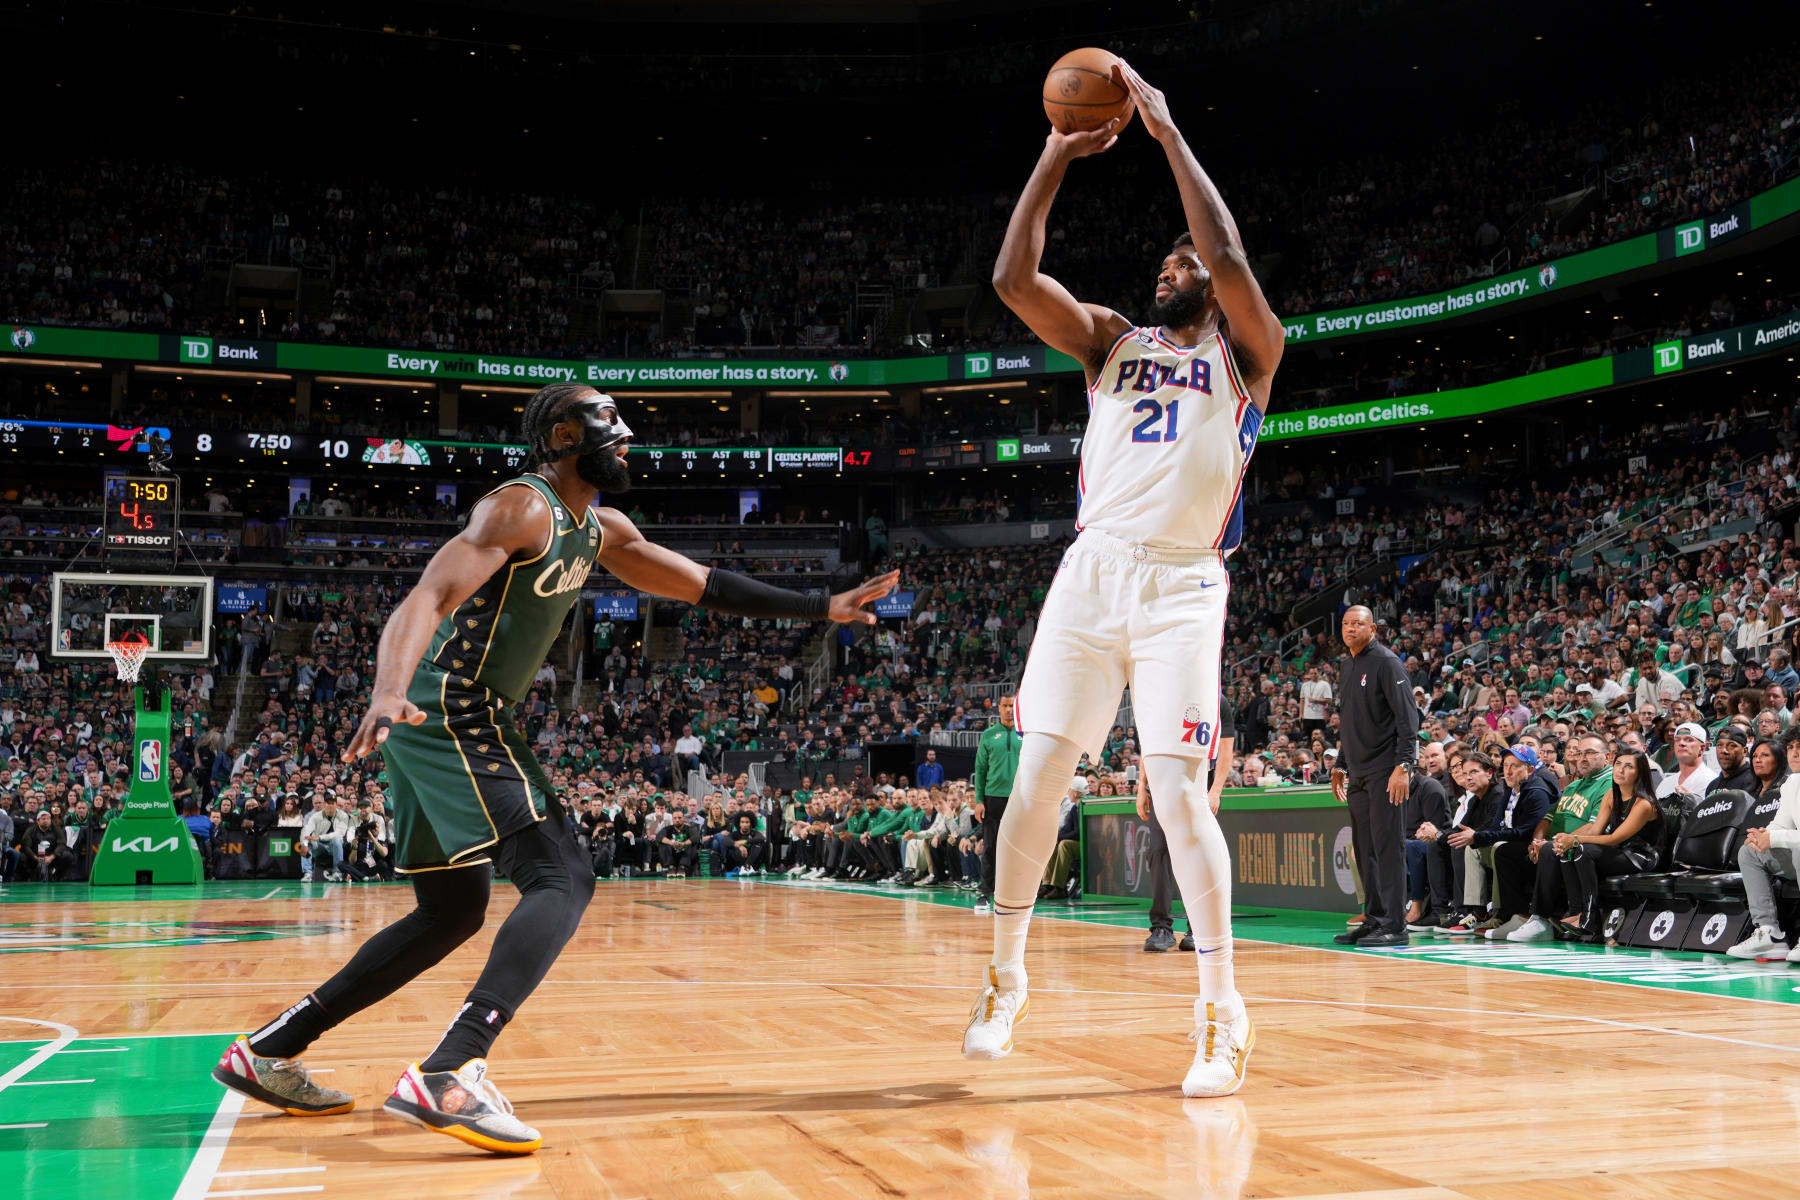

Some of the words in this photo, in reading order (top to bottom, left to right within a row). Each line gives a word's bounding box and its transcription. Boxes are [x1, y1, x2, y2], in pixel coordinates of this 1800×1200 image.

[1678, 226, 1701, 249] TD
[1710, 214, 1738, 239] Bank
[1316, 313, 1363, 334] Every
[1365, 299, 1445, 325] customer
[1447, 294, 1473, 311] has
[1476, 291, 1486, 303] a
[1487, 277, 1530, 299] story.
[183, 341, 209, 359] TD
[219, 345, 259, 360] Bank
[1656, 346, 1680, 368] TD
[1688, 338, 1725, 359] Bank
[1755, 318, 1800, 346] Americ
[387, 353, 439, 373] Every
[443, 358, 475, 373] win
[478, 359, 511, 375] has
[514, 364, 525, 376] a
[528, 365, 577, 381] story.
[587, 365, 635, 382] Every
[638, 367, 720, 380] customer
[723, 365, 754, 380] has
[756, 368, 768, 380] a
[770, 367, 818, 382] story.
[968, 357, 990, 374] TD
[997, 356, 1031, 370] Bank
[1132, 398, 1180, 443] 21
[1259, 421, 1275, 437] of
[1278, 418, 1304, 434] the
[1307, 410, 1366, 430] Boston
[1368, 402, 1434, 422] Celtics.
[2, 433, 17, 444] 33
[53, 436, 60, 446] 7
[82, 437, 90, 447] 2
[196, 434, 212, 452] 8
[247, 433, 291, 450] 7:50
[263, 448, 276, 456] 1st
[319, 440, 349, 458] 10
[502, 447, 526, 456] FG%
[649, 451, 663, 459] TO
[682, 451, 697, 459] STL
[712, 451, 730, 459] AST
[743, 450, 761, 459] REB
[774, 452, 801, 462] CELTICS
[803, 452, 839, 462] PLAYOFFS
[998, 443, 1019, 457] TD
[1023, 442, 1051, 454] Bank
[447, 455, 454, 464] 7
[476, 456, 482, 465] 1
[507, 458, 520, 467] 57
[654, 461, 660, 470] 1
[687, 461, 693, 470] 0
[718, 461, 726, 470] 4
[749, 461, 756, 470] 3
[844, 451, 872, 466] 4.7
[130, 482, 167, 500] 7:50
[121, 502, 153, 529] 4.5
[553, 506, 564, 520] 6
[126, 535, 171, 545] TISSOT
[1181, 718, 1211, 746] 76
[127, 801, 153, 810] Google
[1697, 800, 1733, 818] @celtics
[112, 836, 179, 853] KIA
[271, 841, 289, 853] TD
[1239, 832, 1277, 885] BEGIN
[1280, 832, 1316, 887] JUNE
[1318, 832, 1325, 888] 1
